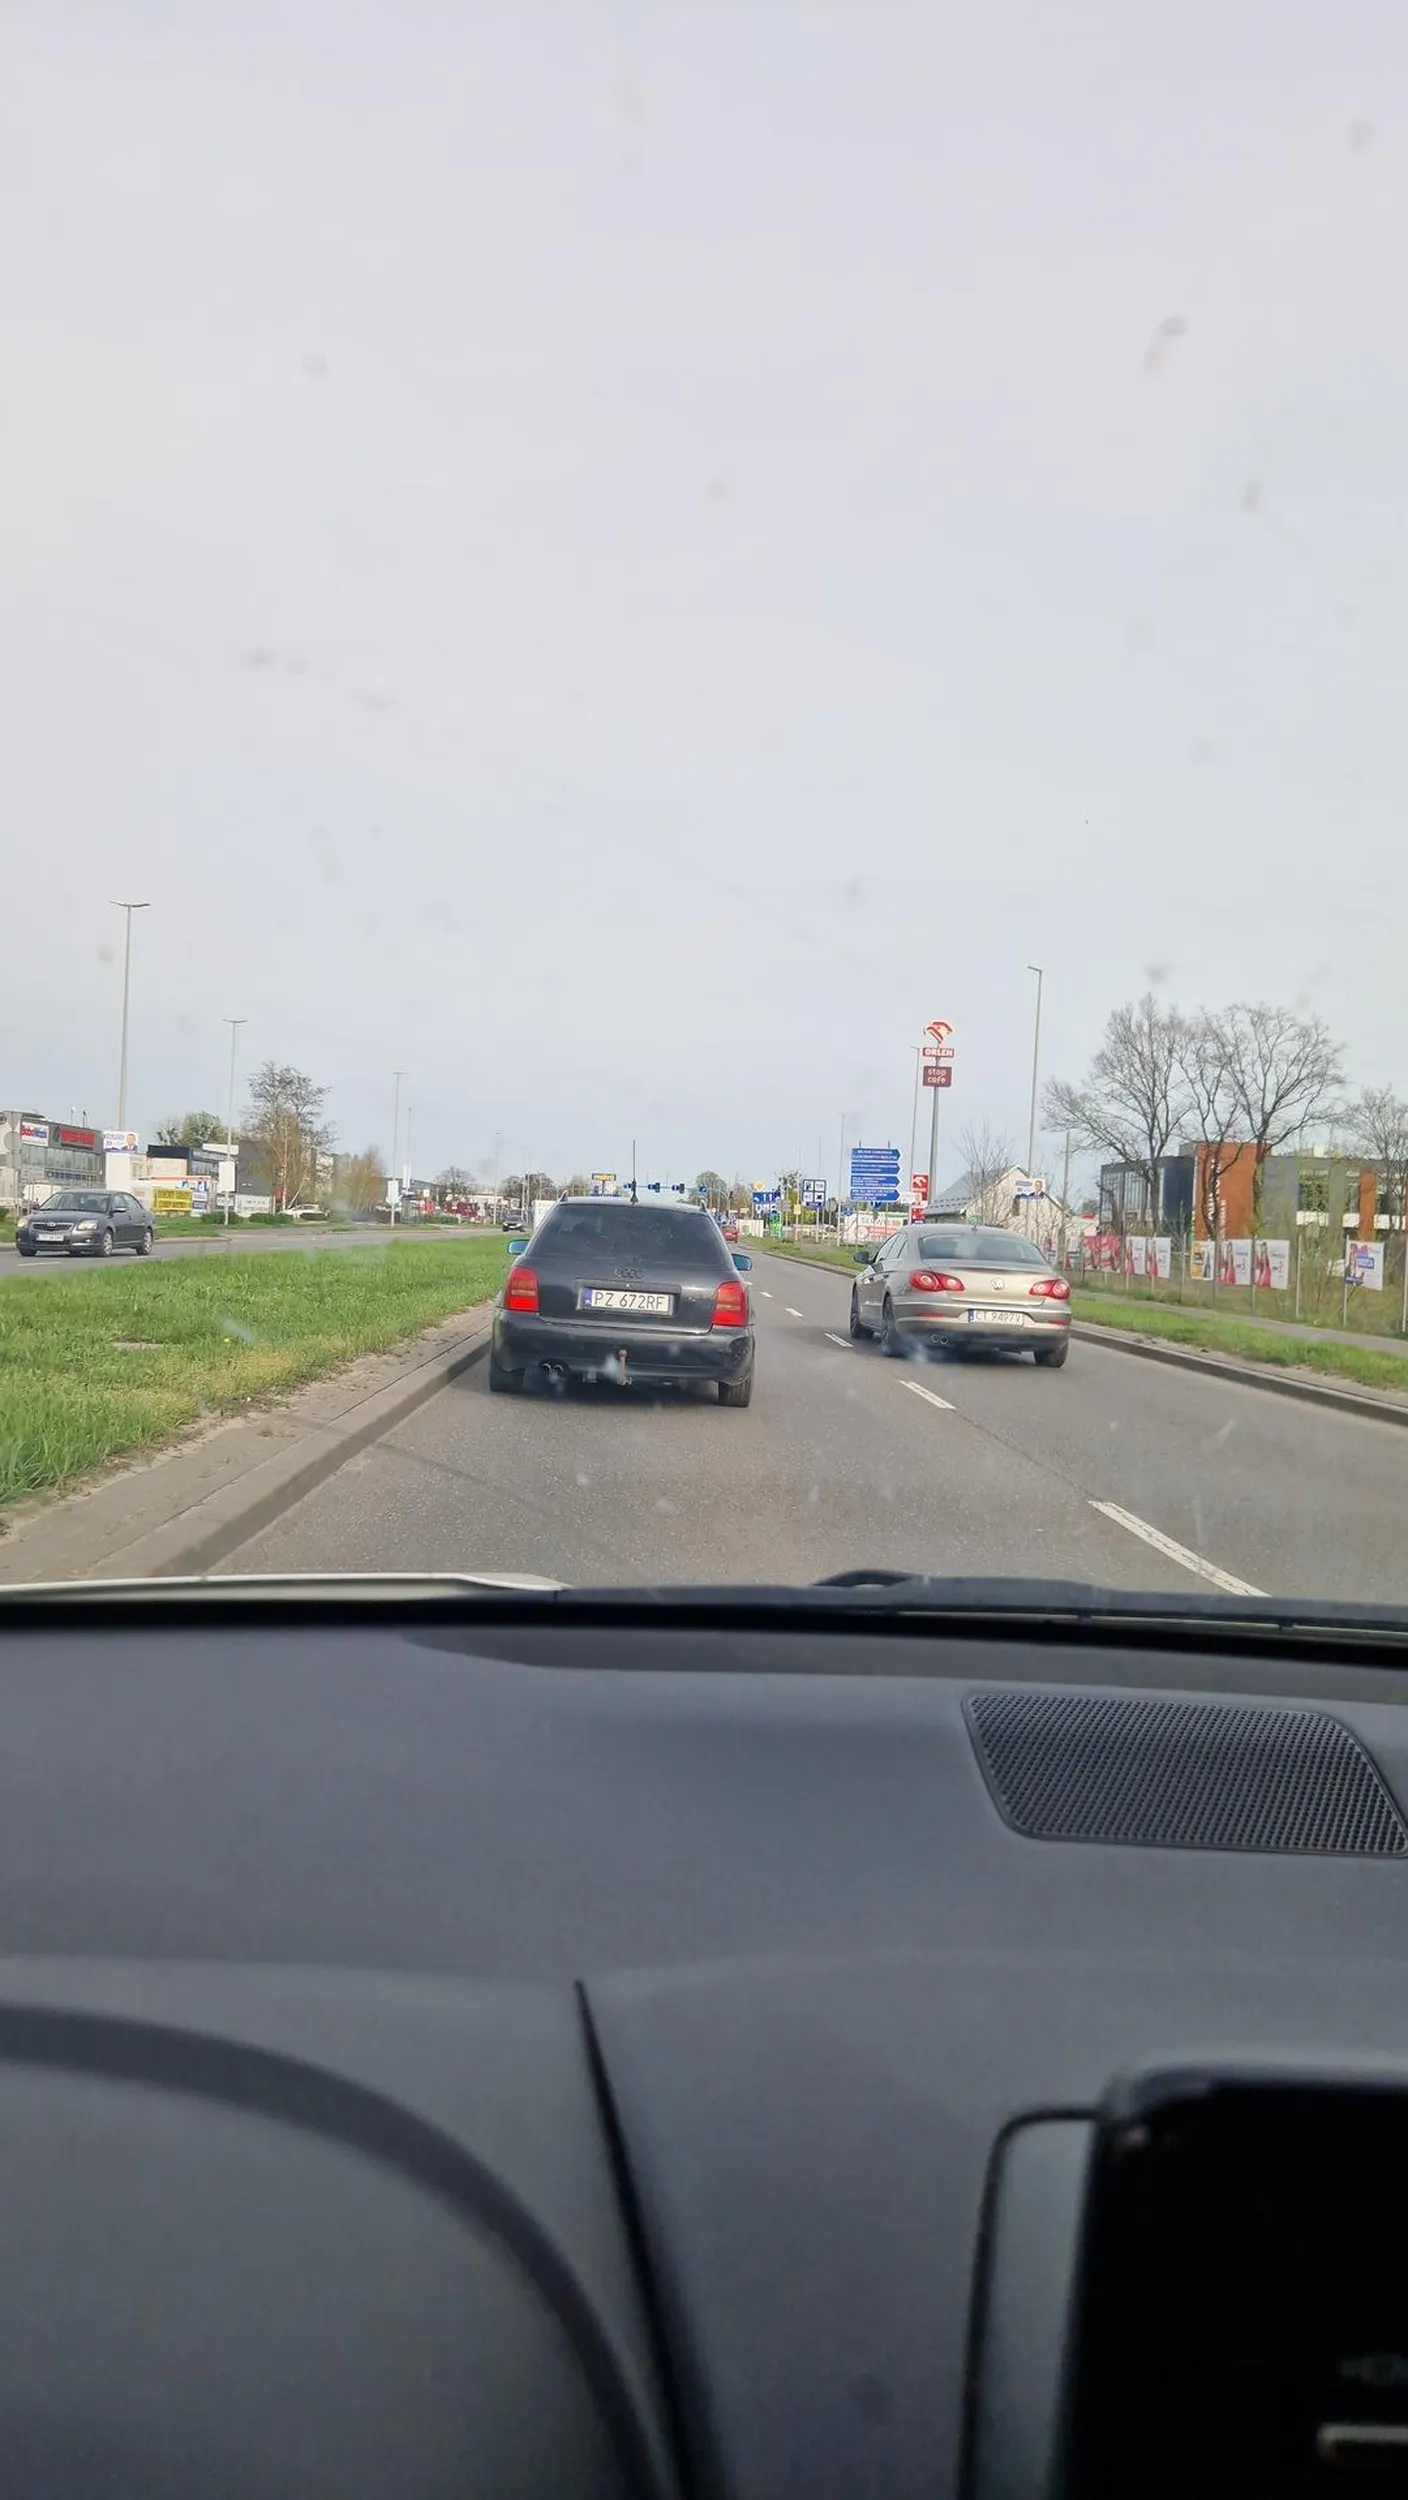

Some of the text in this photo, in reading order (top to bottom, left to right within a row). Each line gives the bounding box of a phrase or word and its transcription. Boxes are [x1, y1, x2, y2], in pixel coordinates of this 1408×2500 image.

[924, 1048, 953, 1056] ORLEN
[928, 1068, 946, 1077] stop
[927, 1076, 946, 1084] cafe
[594, 1292, 665, 1309] PZ 672RF
